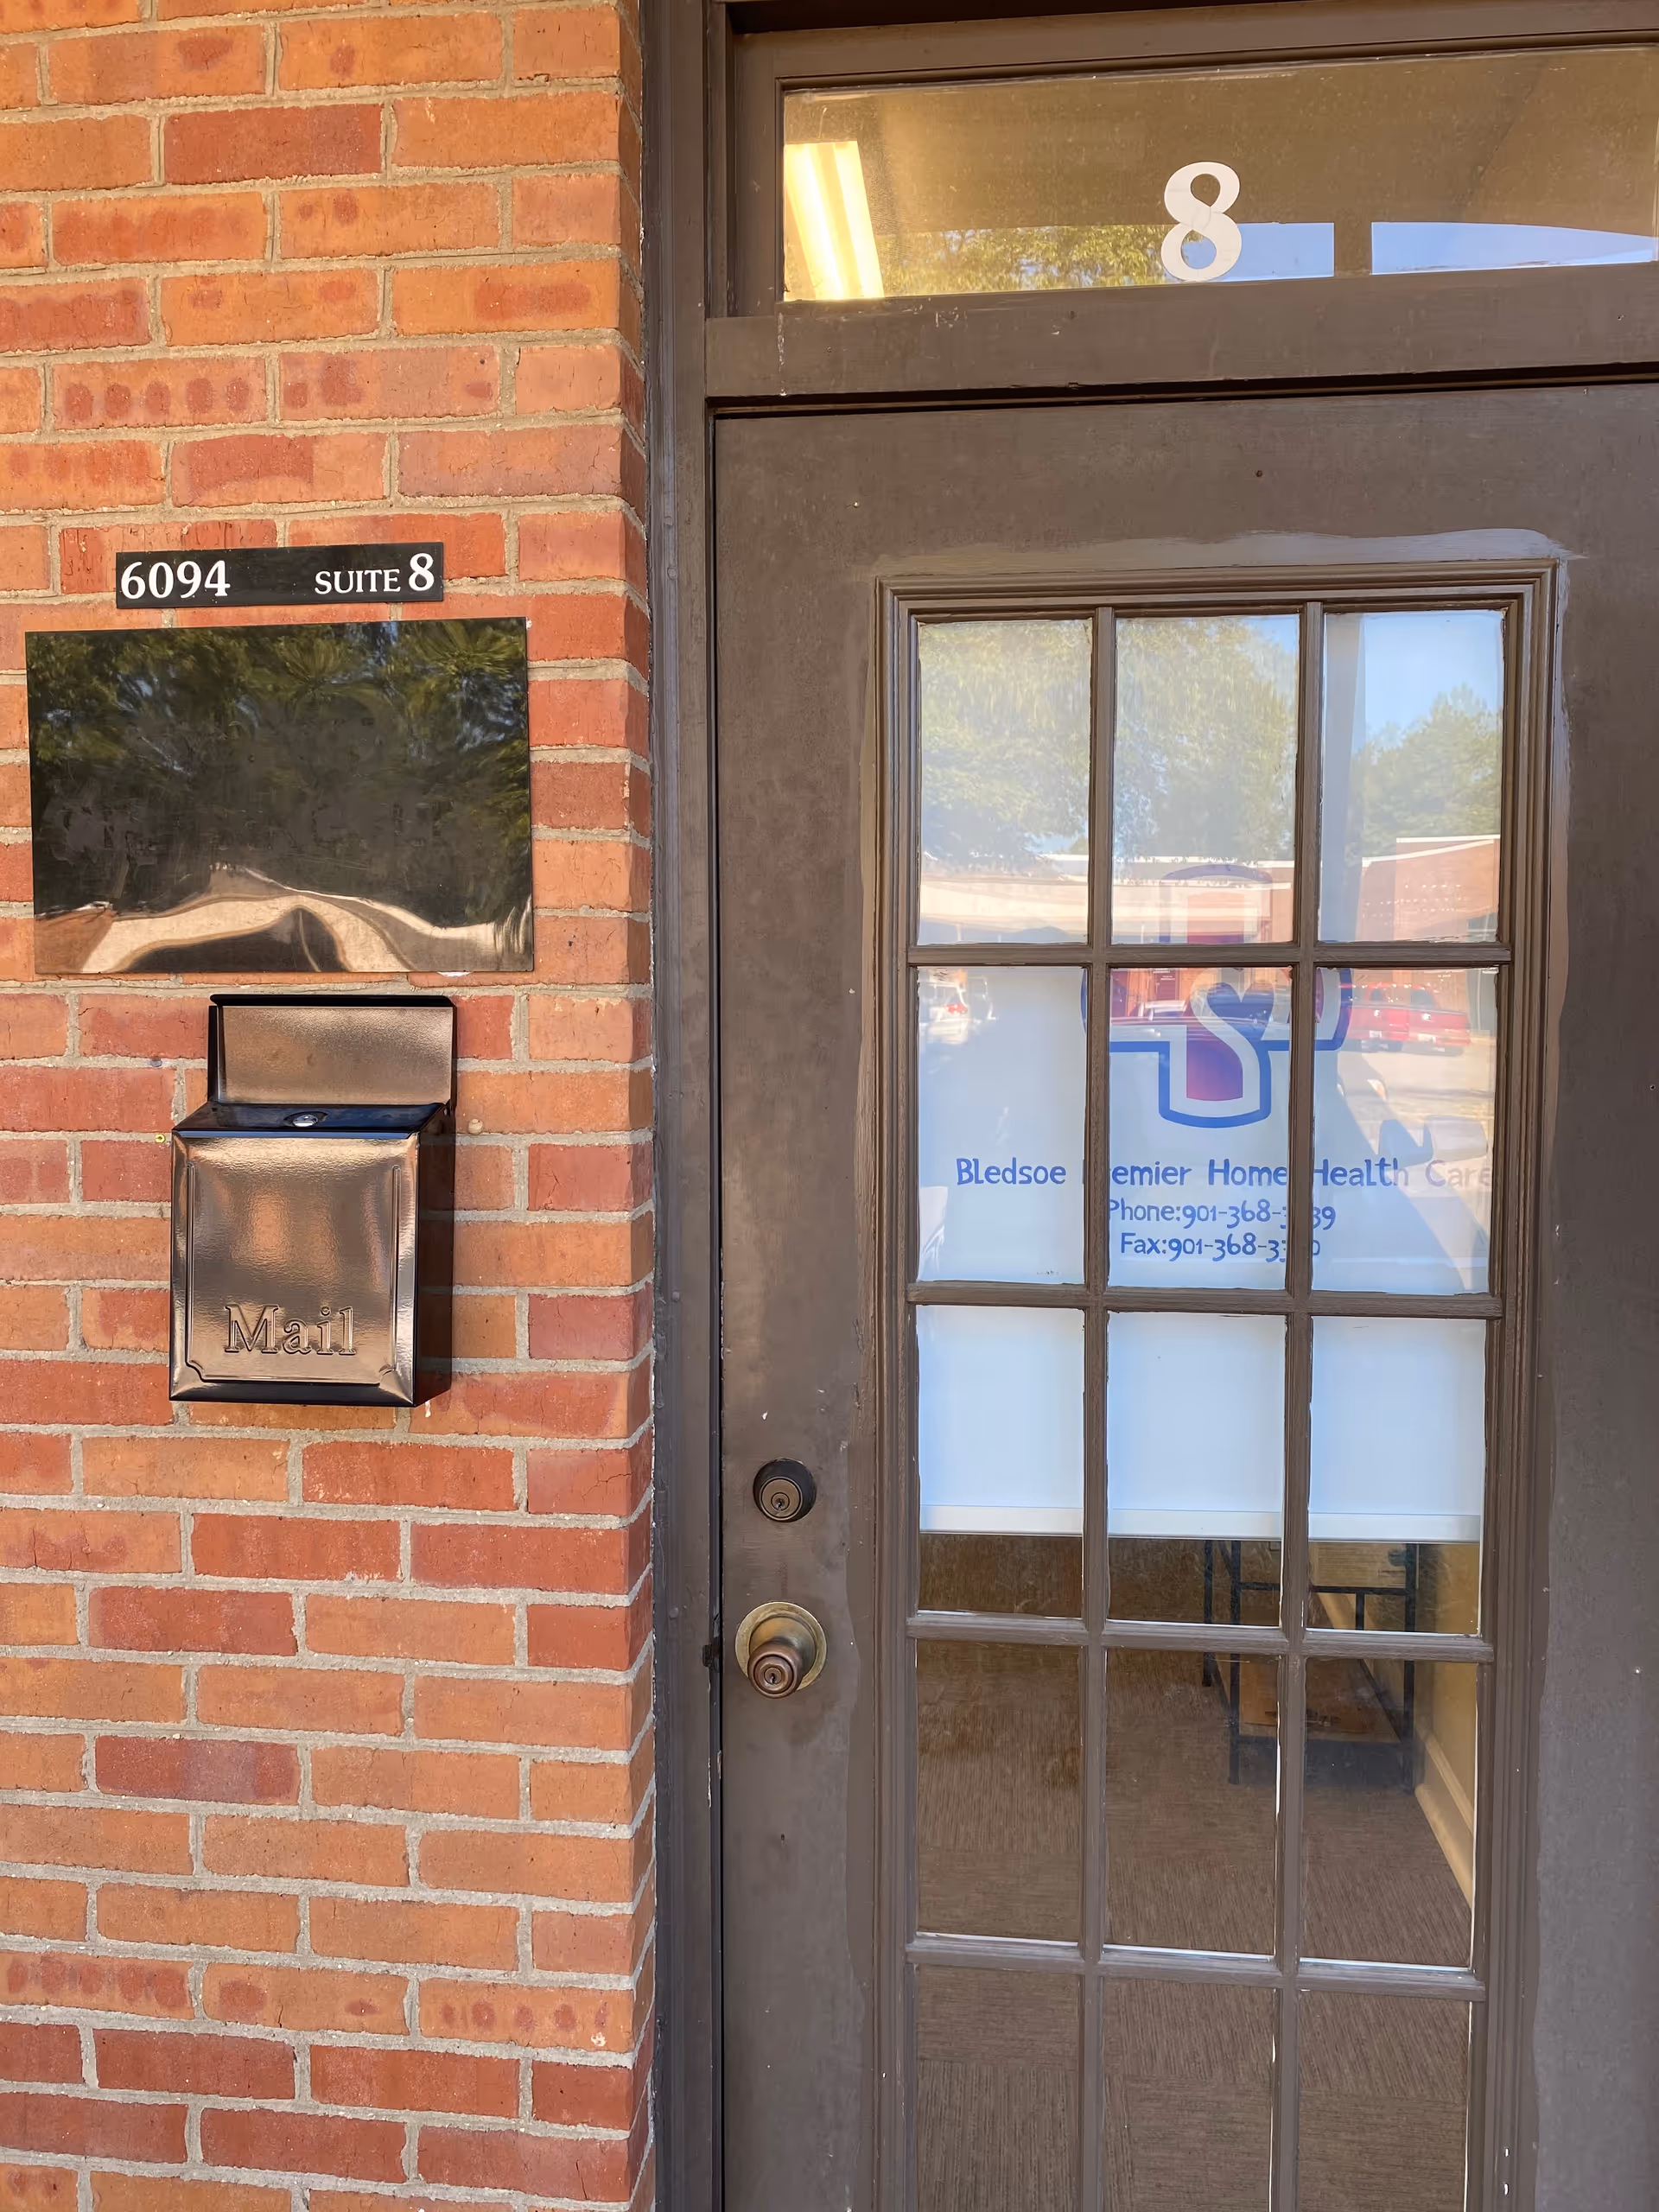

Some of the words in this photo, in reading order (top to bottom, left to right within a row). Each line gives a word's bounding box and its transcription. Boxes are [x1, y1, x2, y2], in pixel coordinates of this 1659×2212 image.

[1160, 161, 1243, 282] 8
[120, 560, 231, 600] 6094
[314, 569, 402, 595] SUITE
[407, 552, 435, 592] 8
[956, 1156, 1067, 1185] Bledsoe
[1083, 1160, 1192, 1186] emier
[1207, 1158, 1287, 1186] Home
[1425, 1159, 1492, 1188] Care
[1109, 1198, 1337, 1230] Phone:901-368-39
[1120, 1232, 1321, 1263] Fax:901-368-30
[224, 1302, 357, 1357] Mail
